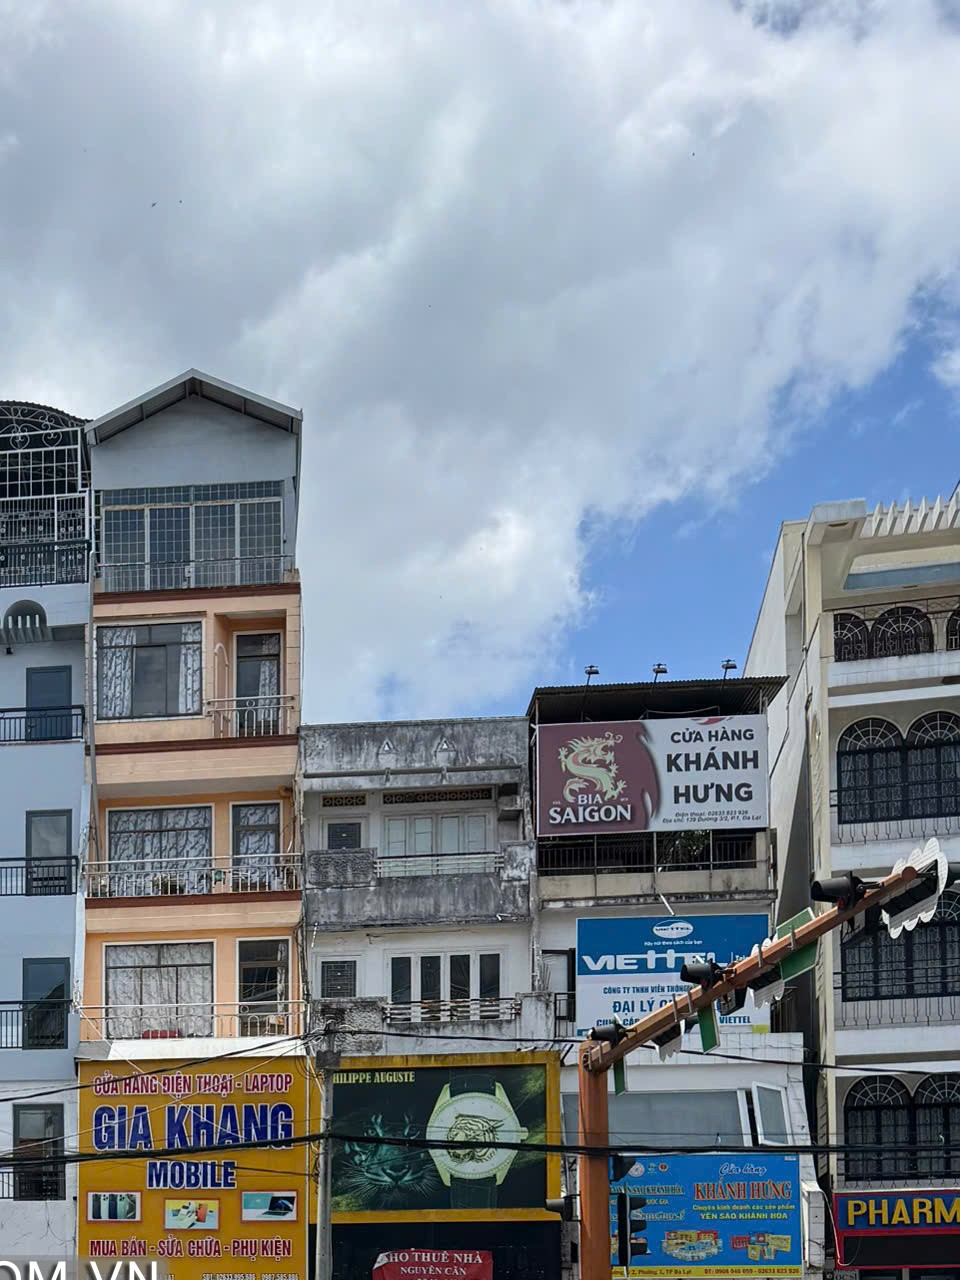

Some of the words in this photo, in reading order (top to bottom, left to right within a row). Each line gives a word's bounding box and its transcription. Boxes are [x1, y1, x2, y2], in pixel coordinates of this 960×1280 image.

[670, 729, 704, 743] CỬA
[708, 726, 754, 742] HÀNG
[666, 747, 759, 772] KHÁNH
[578, 793, 603, 804] BIA
[673, 782, 753, 804] HƯNG
[549, 804, 632, 824] SAIGON
[623, 986, 630, 994] TY
[612, 1000, 635, 1015] ĐẠI
[640, 996, 655, 1012] LÝ
[719, 1015, 751, 1024] VIETTEL
[94, 1071, 119, 1095] CỬA
[123, 1072, 158, 1095] HÀNG
[162, 1071, 192, 1099] ĐIỆN
[244, 1073, 293, 1093] LAPTOP
[331, 1072, 372, 1084] HILIPPE
[374, 1071, 415, 1083] AUGUSTE
[93, 1105, 153, 1151] GIA
[166, 1103, 294, 1151] KHANG
[147, 1160, 237, 1190] MOBILE
[695, 1178, 746, 1200] KHÁNH
[750, 1179, 791, 1200] HƯNG
[846, 1198, 960, 1225] PHARM
[90, 1239, 117, 1257] MUA
[120, 1236, 147, 1257] BÁN
[157, 1234, 184, 1258] SỬA
[188, 1236, 222, 1257] CHỮA
[231, 1238, 258, 1262] PHỤ
[260, 1236, 292, 1262] KIỆN
[412, 1250, 451, 1263] THUÊ
[453, 1250, 483, 1264] NHÀ
[401, 1265, 442, 1275] NGUYÊN
[445, 1265, 467, 1276] CĂN
